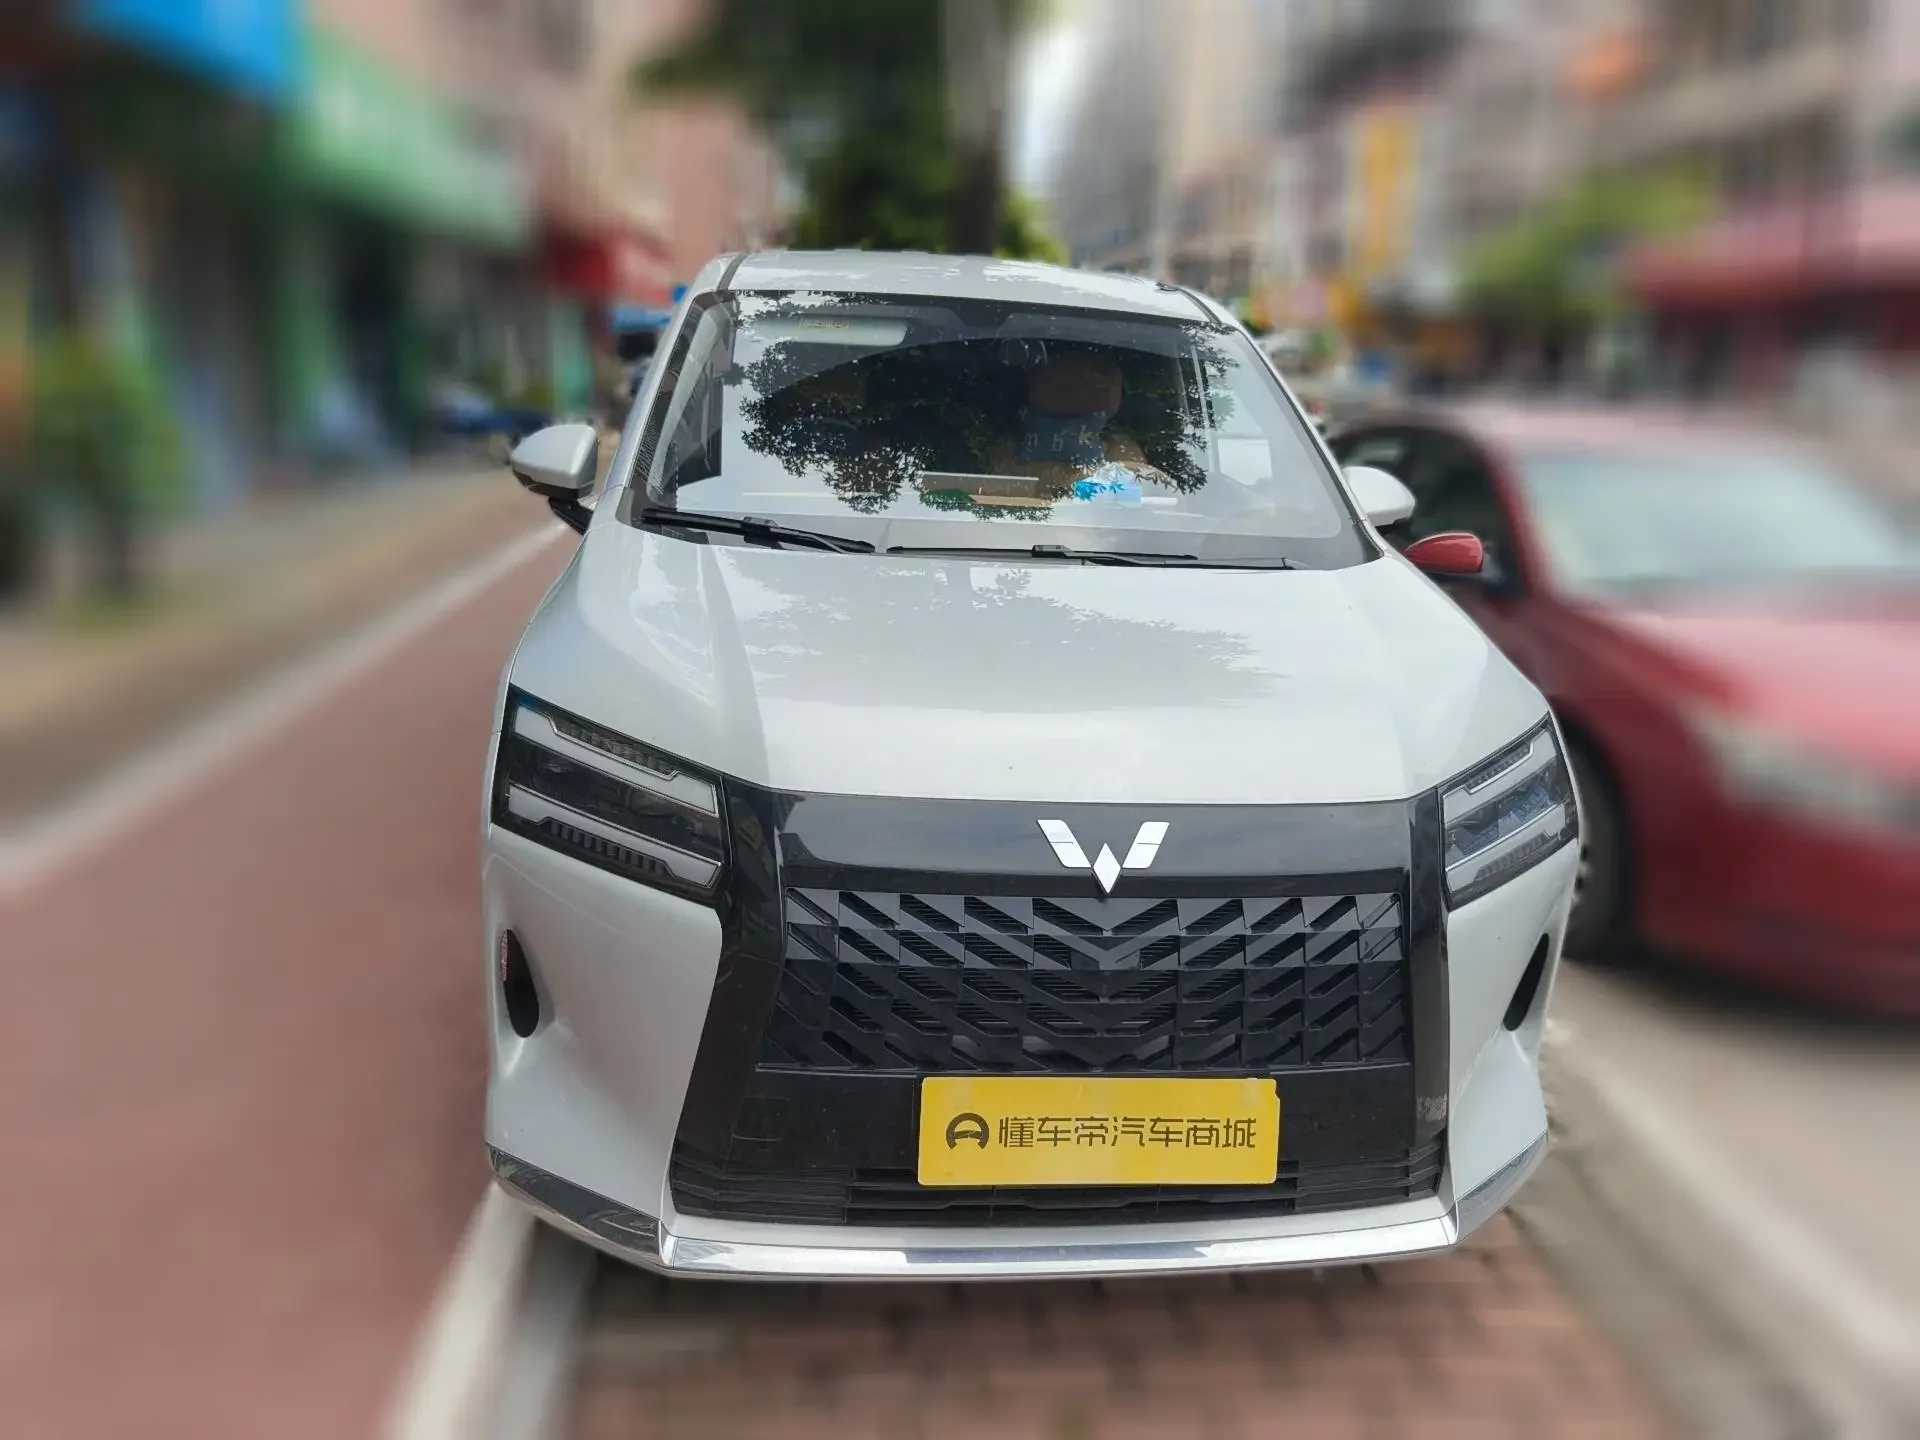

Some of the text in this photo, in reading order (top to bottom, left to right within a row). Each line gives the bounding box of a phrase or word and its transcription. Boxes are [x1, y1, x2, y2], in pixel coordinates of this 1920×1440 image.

[998, 1115, 1257, 1148] 懂车帝汽车商城
